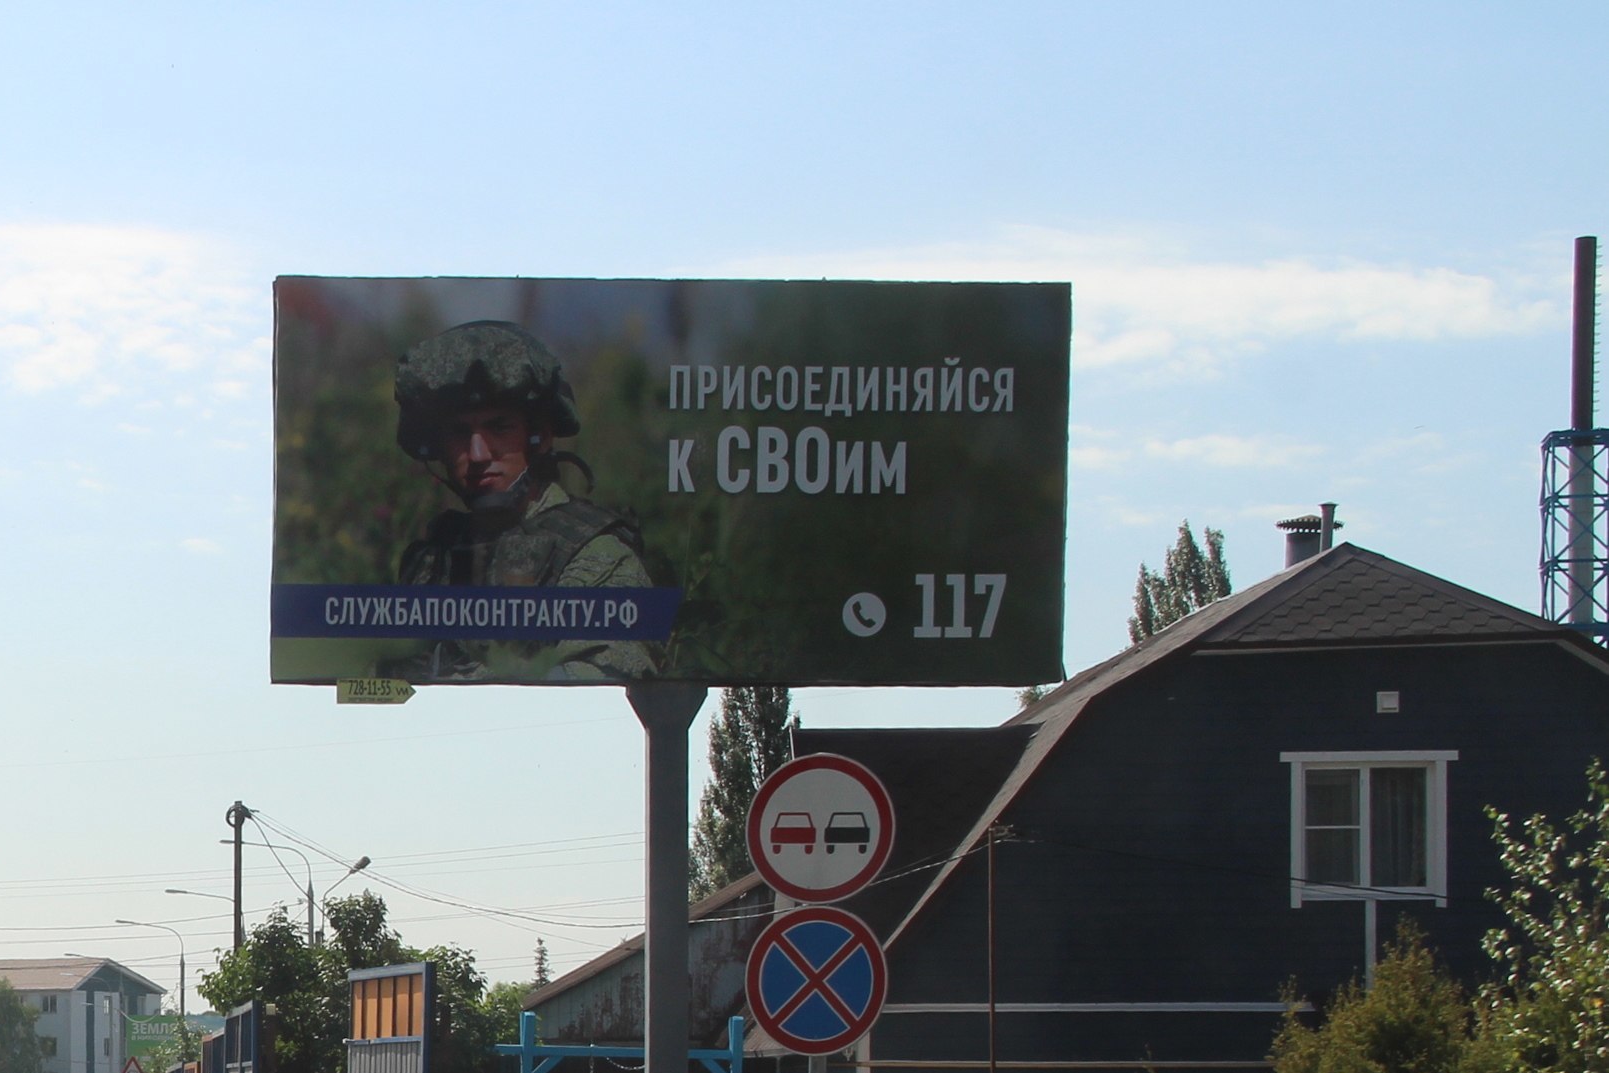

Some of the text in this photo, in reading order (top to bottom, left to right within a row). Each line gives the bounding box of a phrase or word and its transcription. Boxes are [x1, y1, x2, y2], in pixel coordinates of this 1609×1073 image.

[669, 357, 1015, 416] ПРИСОЕДИНЯЙСЯ
[325, 597, 638, 628] СЛУЖБАПОКОНТРАКТУ.РФ
[913, 573, 1007, 638] 117
[349, 680, 391, 696] 728-11-55
